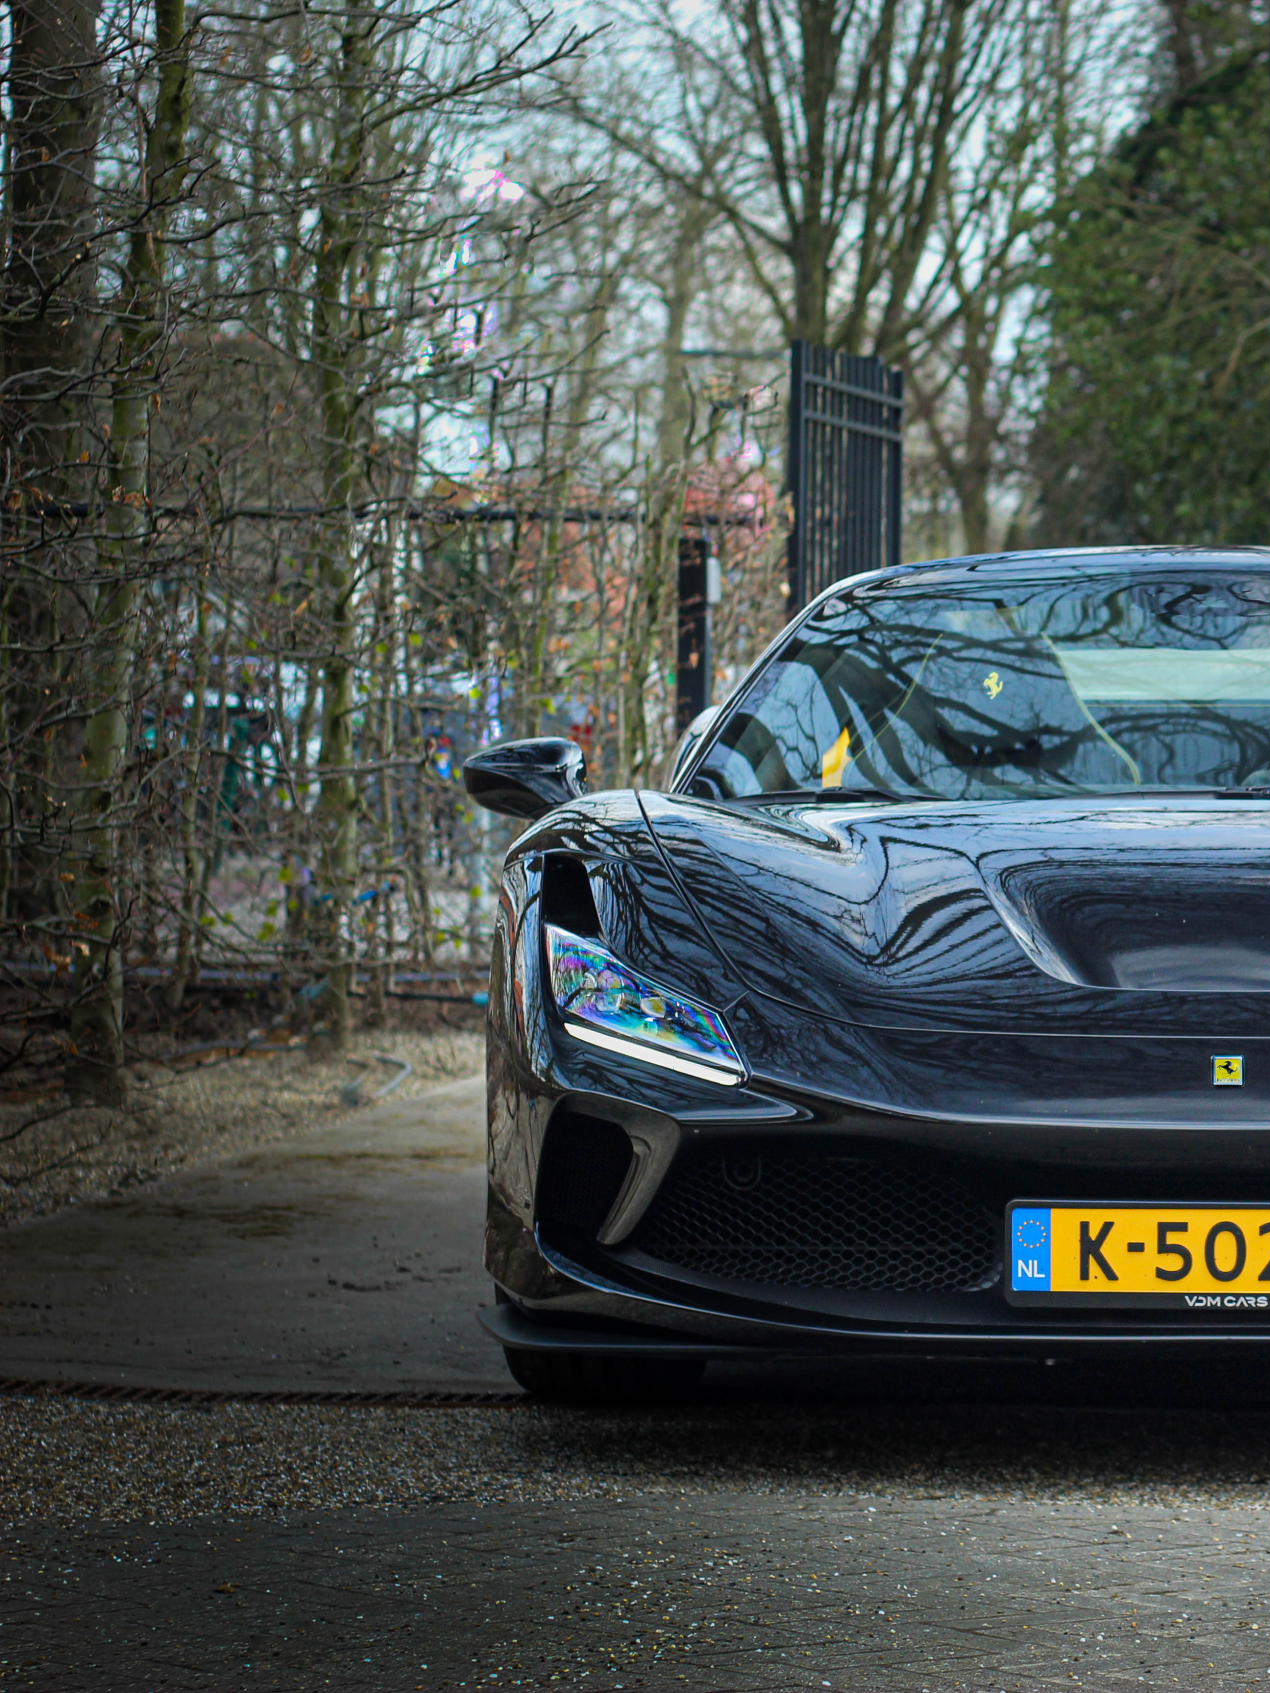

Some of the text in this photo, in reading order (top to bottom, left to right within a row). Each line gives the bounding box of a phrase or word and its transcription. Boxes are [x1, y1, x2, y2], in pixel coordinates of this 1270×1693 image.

[1017, 1259, 1046, 1278] NL
[1184, 1295, 1268, 1308] VDM CARS
